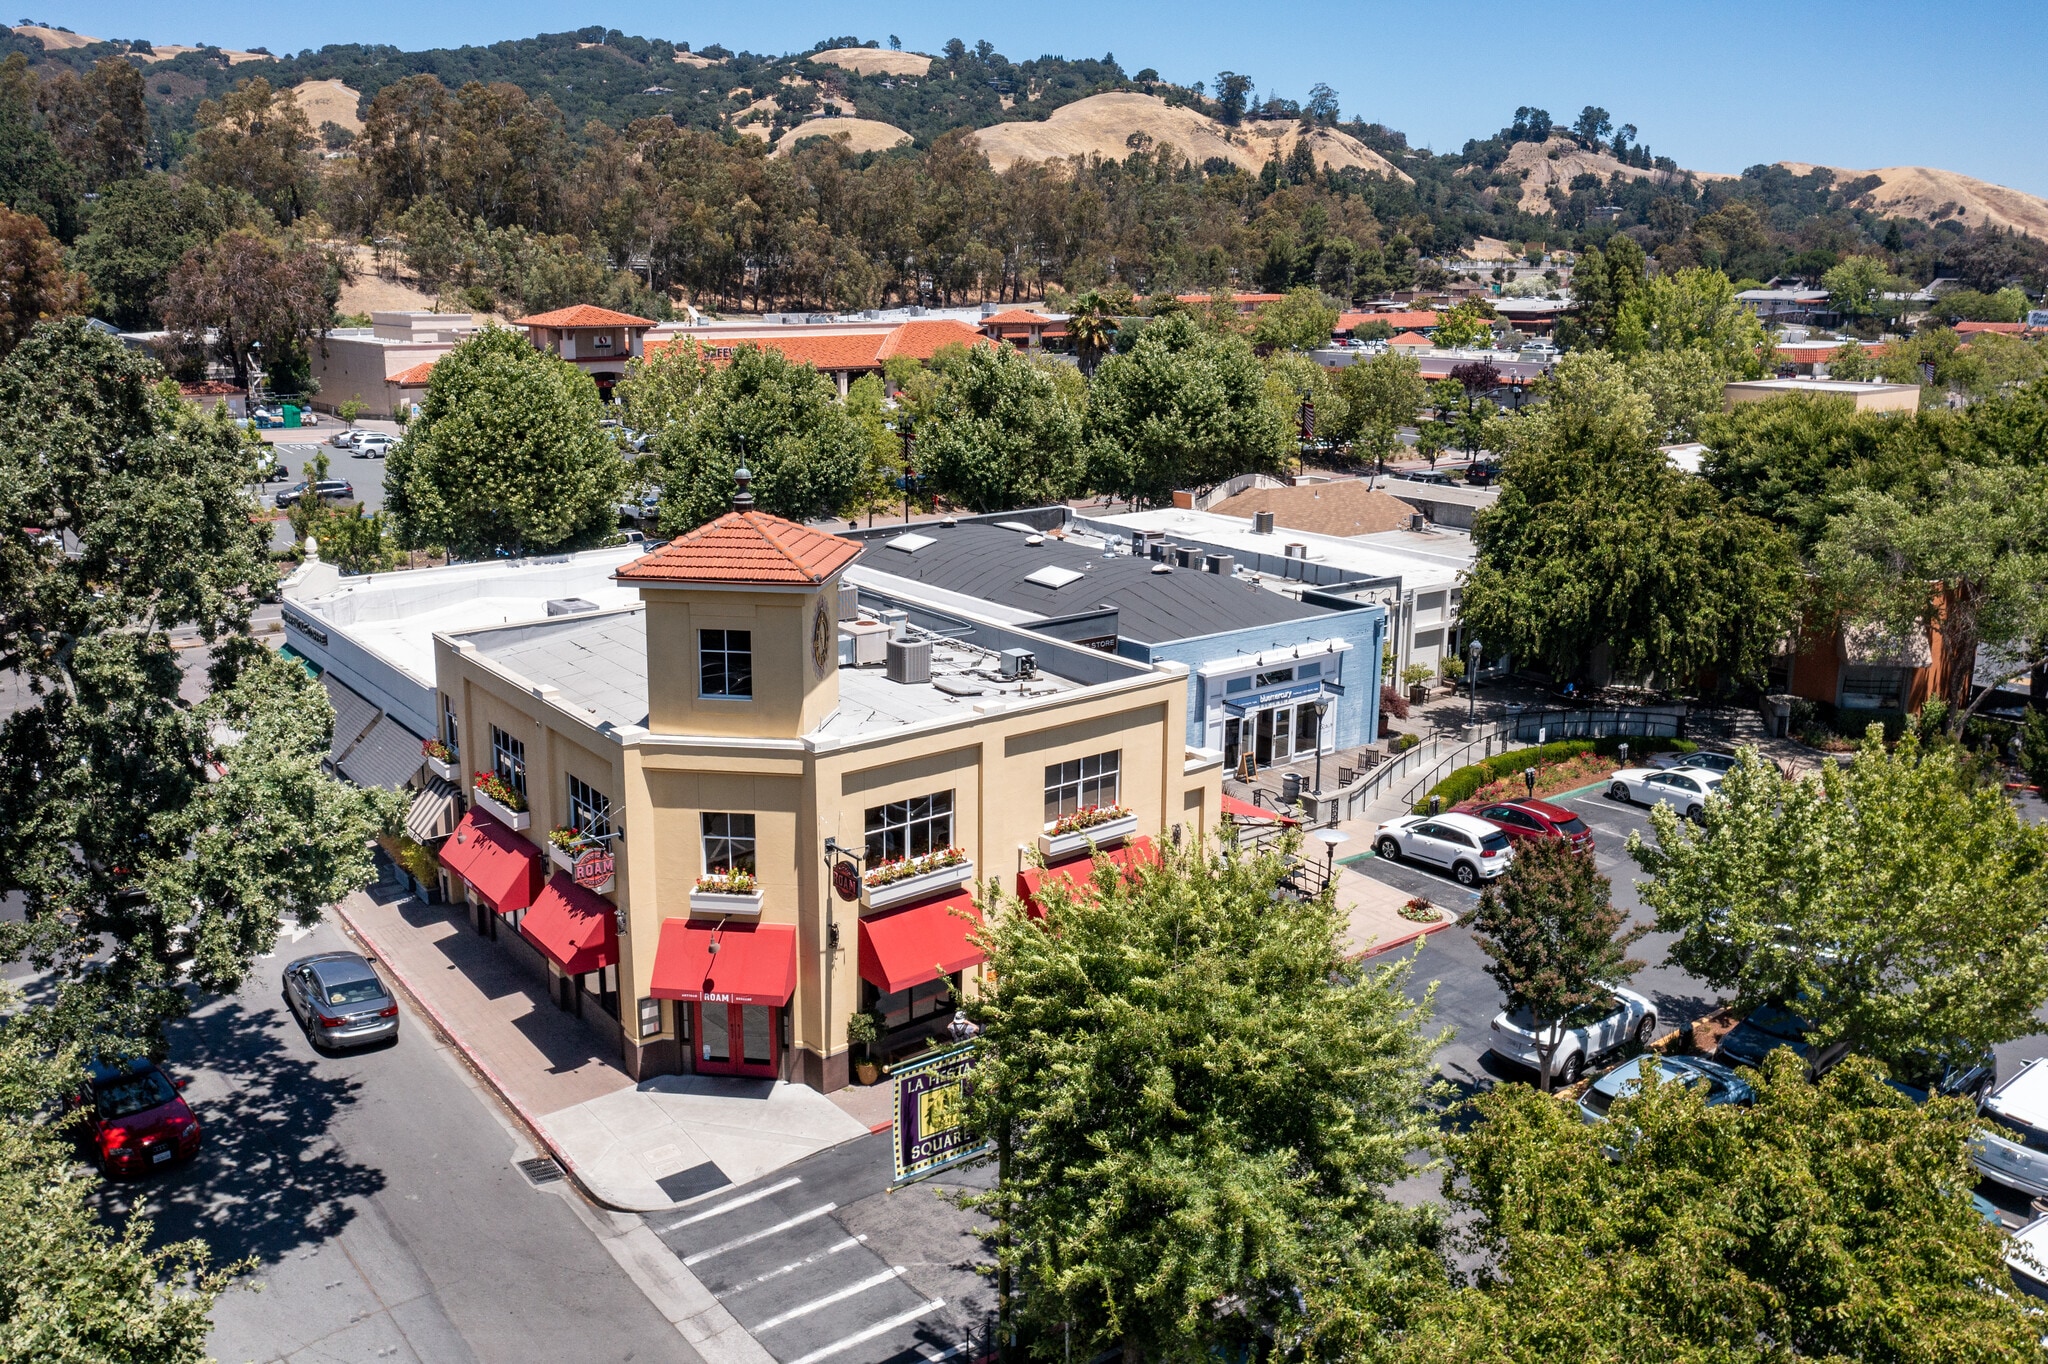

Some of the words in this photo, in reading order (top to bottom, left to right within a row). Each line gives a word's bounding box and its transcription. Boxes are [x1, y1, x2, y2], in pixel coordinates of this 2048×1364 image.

[1091, 639, 1115, 649] STORE
[576, 859, 614, 879] ROAM
[833, 870, 856, 894] ROAM
[704, 992, 730, 1002] ROAM
[907, 1078, 925, 1094] LA
[911, 1128, 971, 1160] SQUARE
